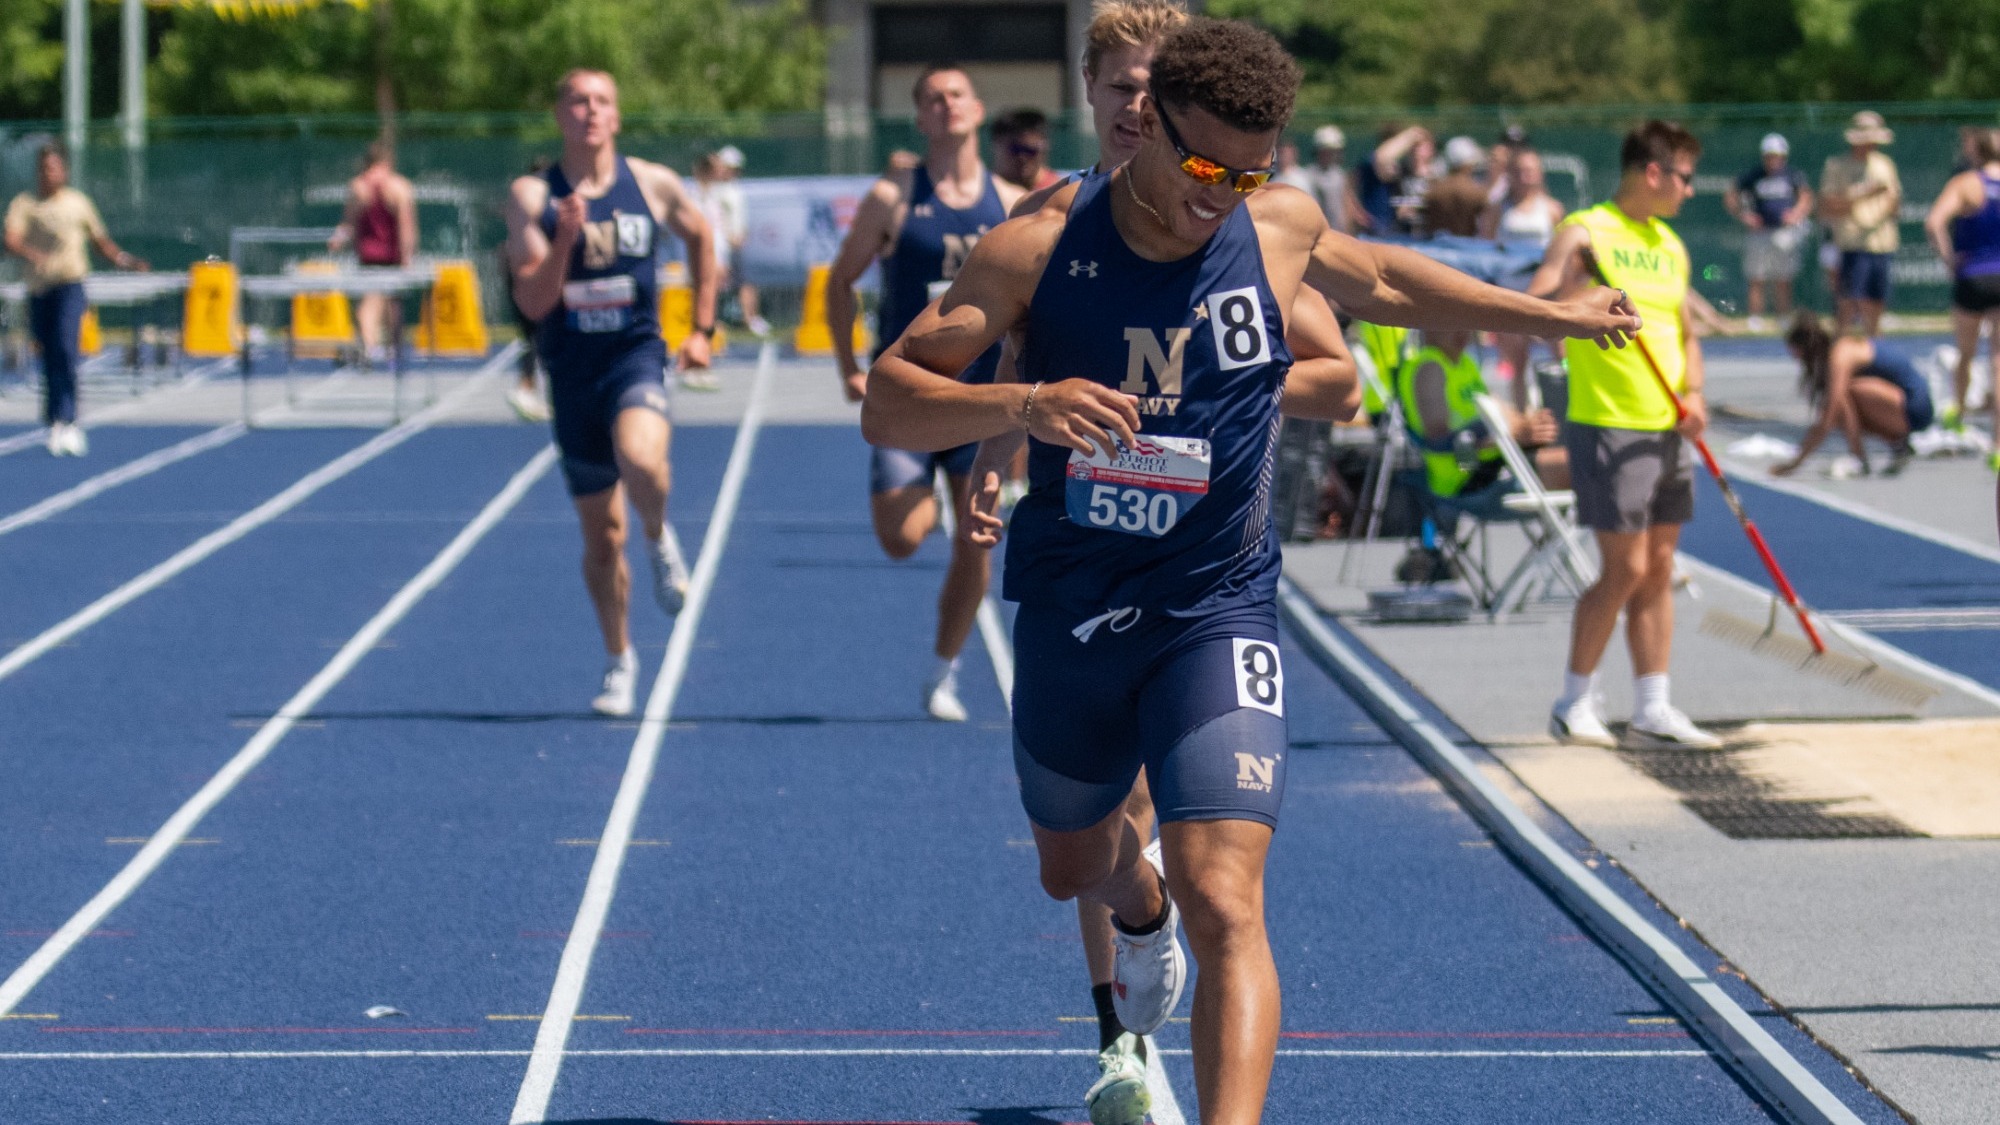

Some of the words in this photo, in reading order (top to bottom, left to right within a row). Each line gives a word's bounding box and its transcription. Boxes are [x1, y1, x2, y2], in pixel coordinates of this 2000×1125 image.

[623, 220, 643, 250] 3
[1219, 295, 1262, 363] 8
[1119, 326, 1192, 395] N
[1138, 397, 1182, 417] AVY
[1109, 459, 1168, 474] LEAGUE
[1119, 453, 1169, 466] ATRIOT
[1088, 484, 1178, 535] 530
[1241, 643, 1278, 706] 8
[1234, 752, 1275, 785] N
[1237, 780, 1273, 793] NAVY
